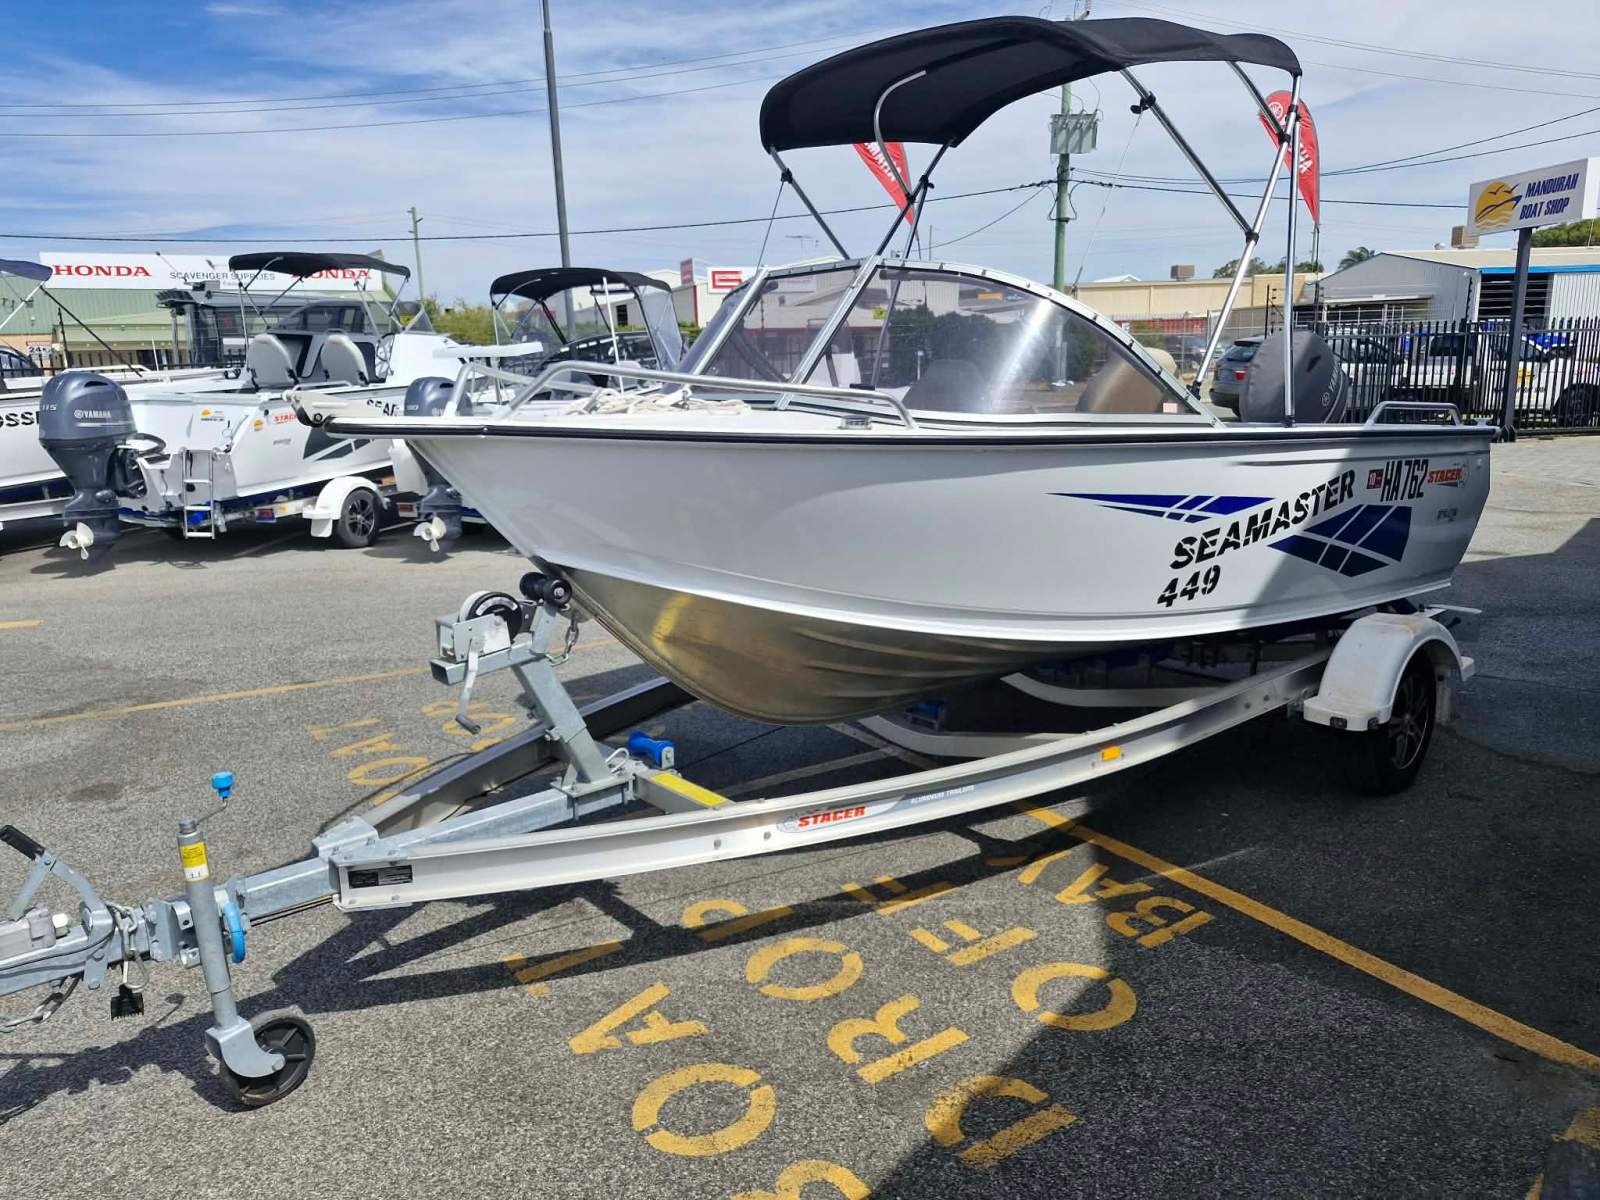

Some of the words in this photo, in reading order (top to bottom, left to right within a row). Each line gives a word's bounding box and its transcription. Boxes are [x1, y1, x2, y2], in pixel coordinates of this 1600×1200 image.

[1525, 173, 1580, 198] MANDURAH
[1520, 201, 1544, 220] BOAT
[1544, 197, 1570, 216] SHOP
[52, 264, 152, 277] HONDA
[169, 271, 229, 281] SCAVENGER
[231, 272, 276, 281] SUPPLIES
[290, 269, 372, 279] ONDA
[83, 410, 112, 419] YAMAHA
[1380, 459, 1429, 502] HA762
[1427, 468, 1463, 485] STACER
[1169, 469, 1356, 570] SEAMASTER
[1156, 564, 1221, 608] 449
[798, 805, 867, 828] STACER
[839, 874, 1138, 1032] OFF
[681, 898, 1078, 1169] DROP
